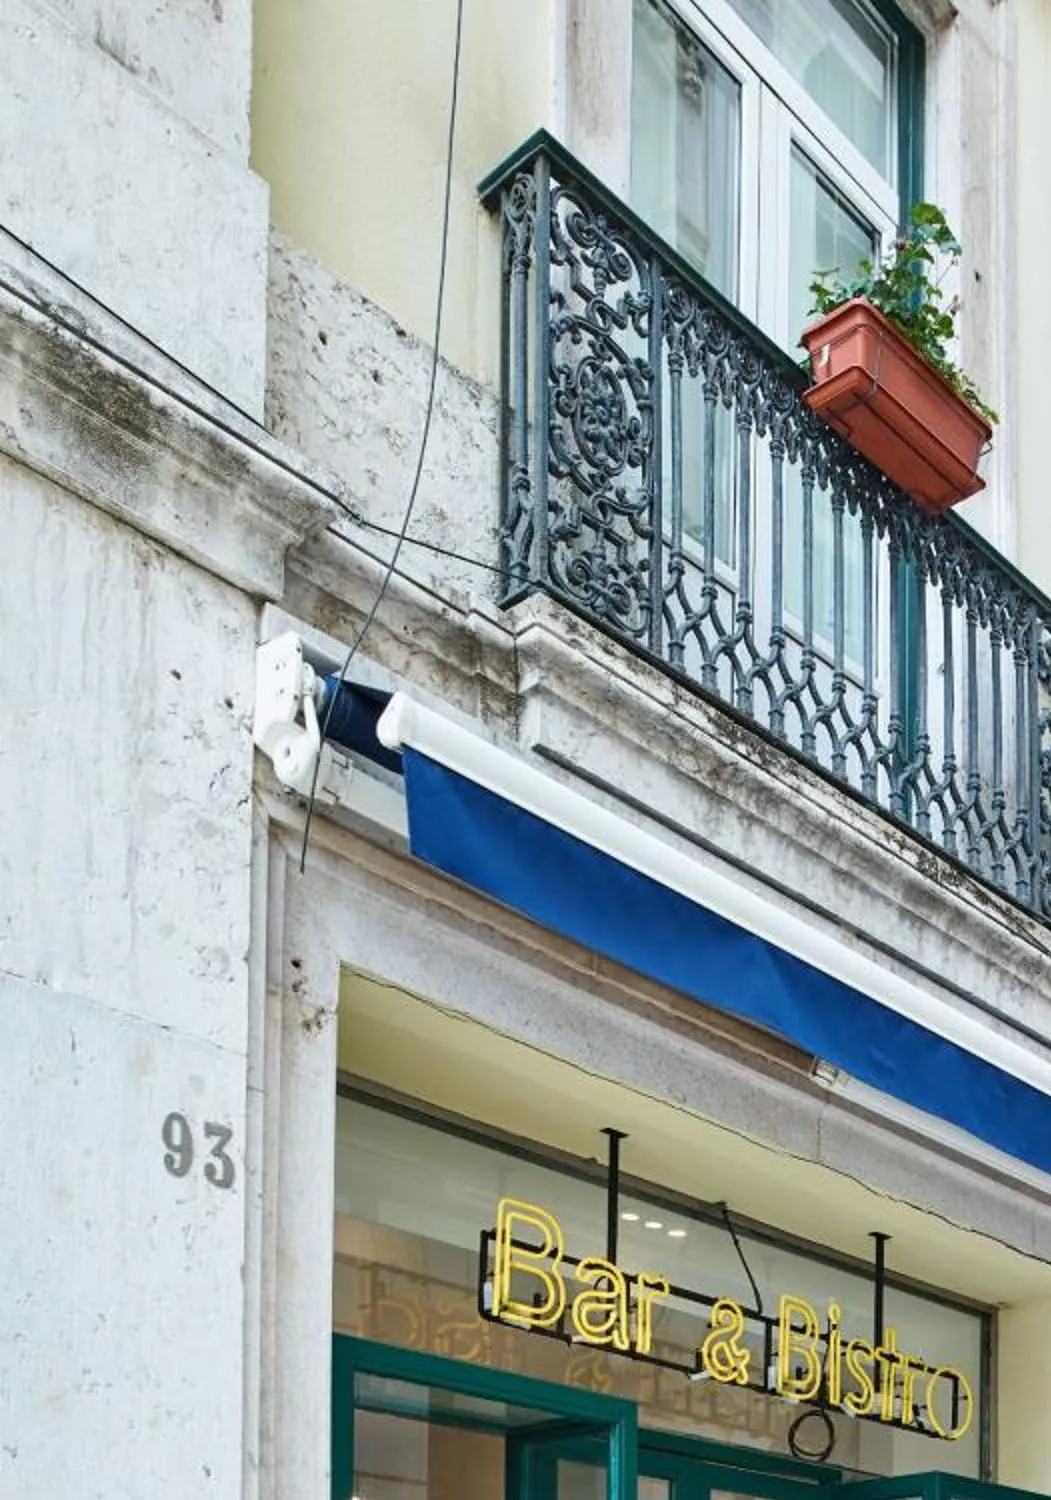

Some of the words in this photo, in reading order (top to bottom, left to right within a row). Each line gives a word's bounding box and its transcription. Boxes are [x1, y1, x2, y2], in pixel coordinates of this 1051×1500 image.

[161, 1111, 236, 1189] 93
[491, 1197, 669, 1353] Bar
[701, 1297, 751, 1386] &
[776, 1294, 974, 1441] Bistro
